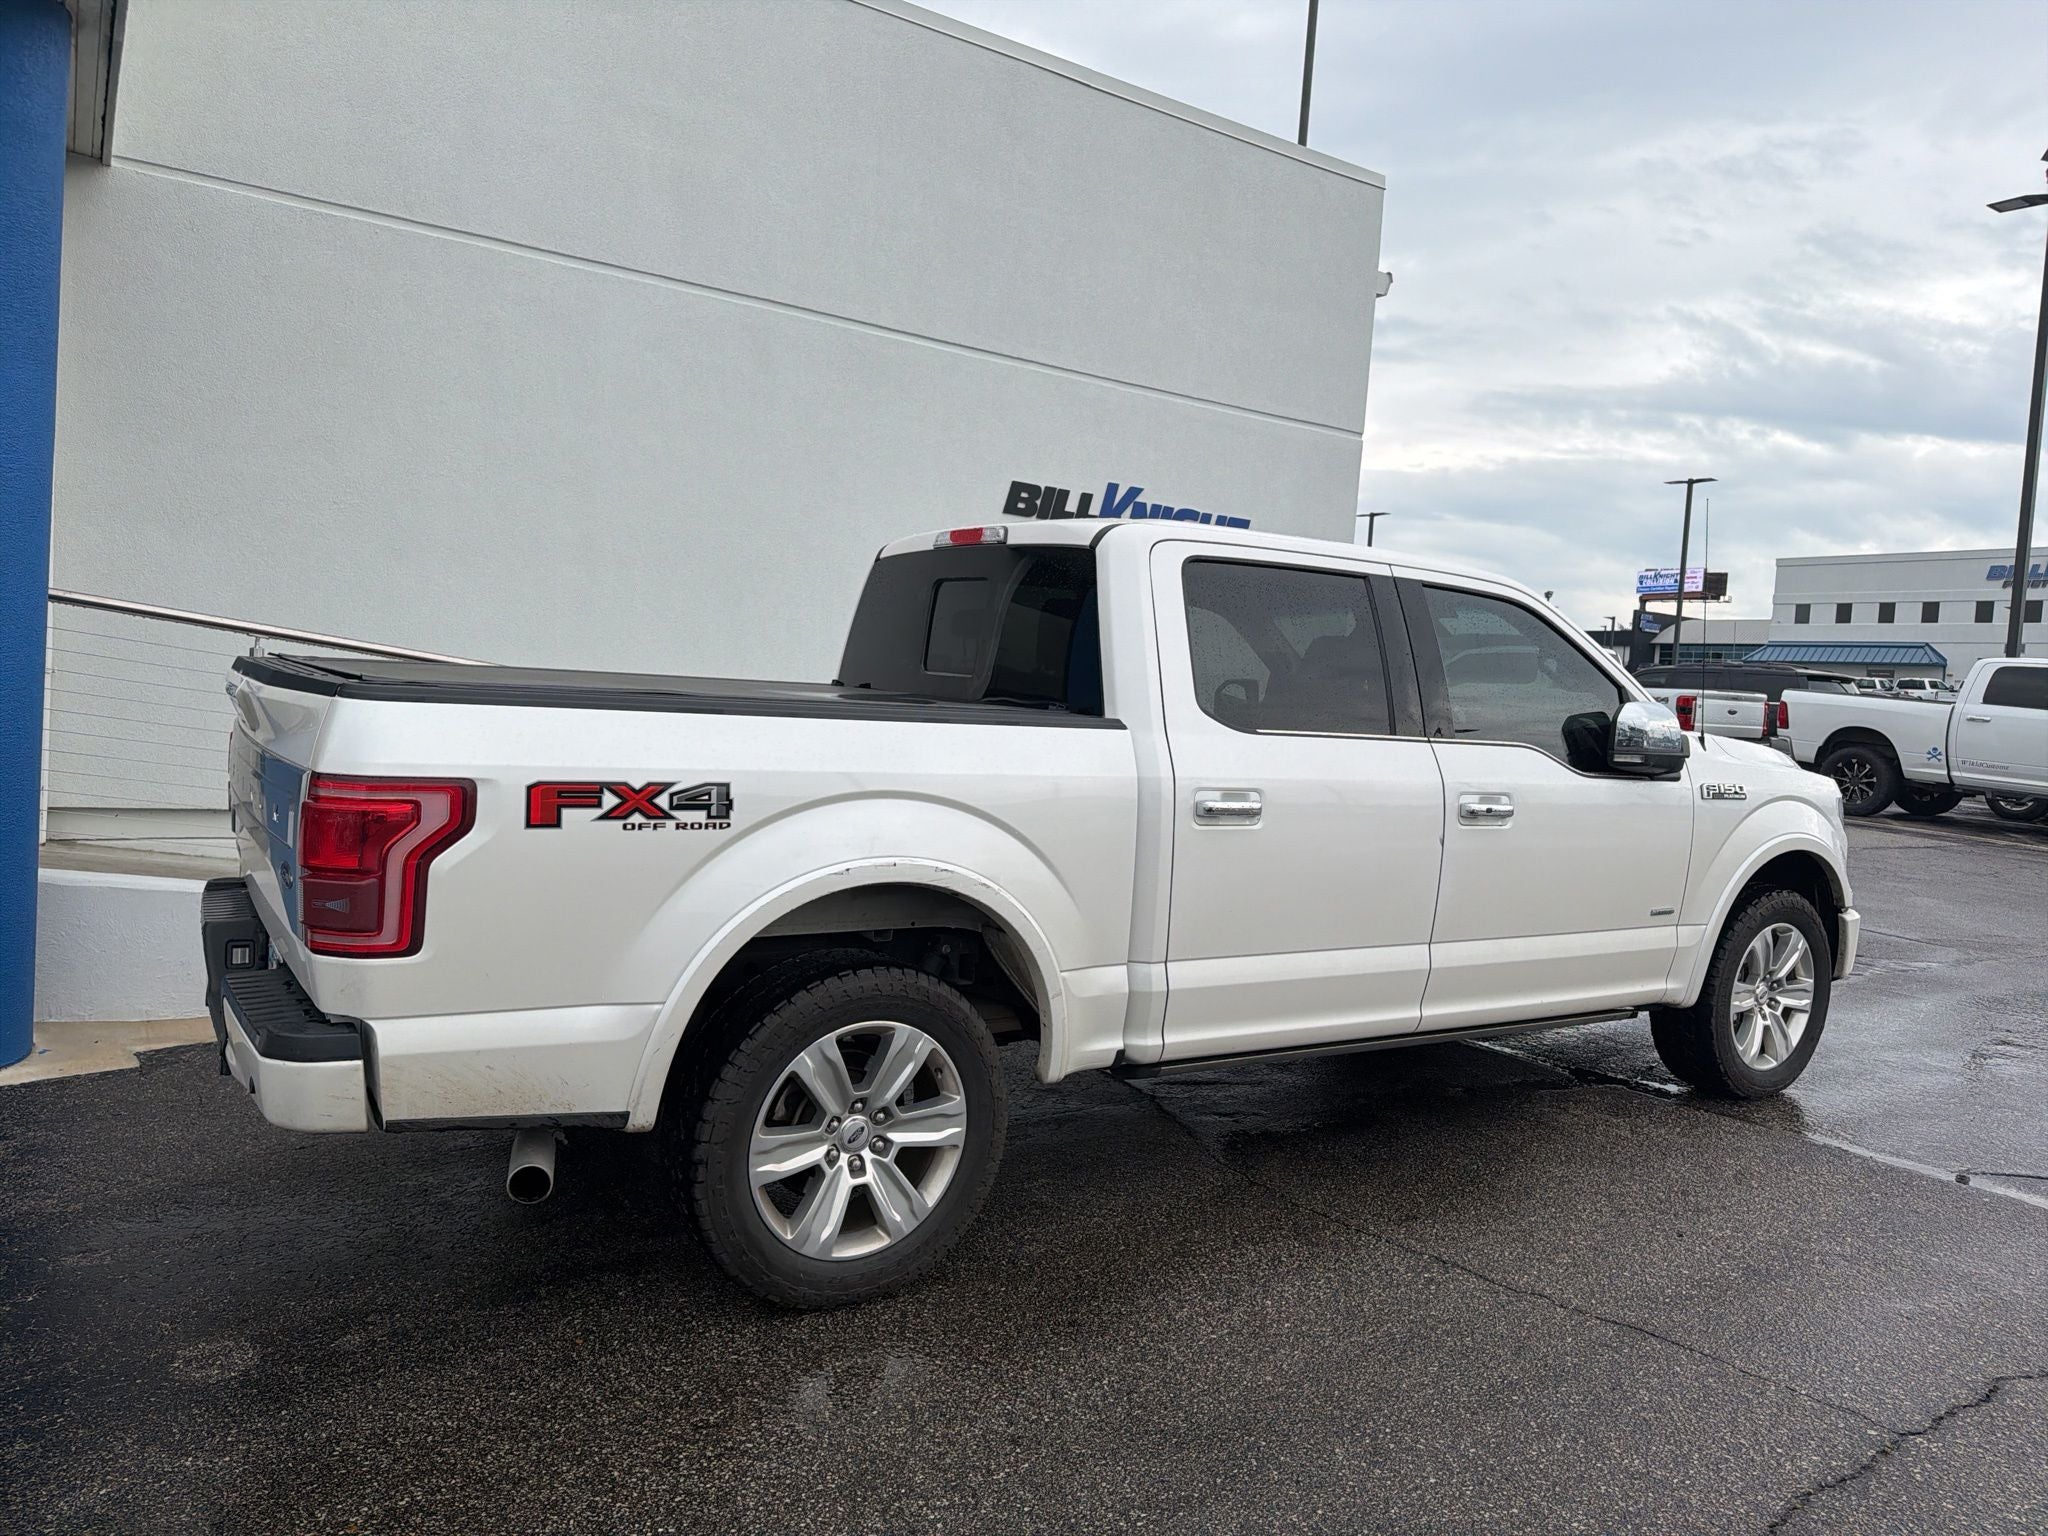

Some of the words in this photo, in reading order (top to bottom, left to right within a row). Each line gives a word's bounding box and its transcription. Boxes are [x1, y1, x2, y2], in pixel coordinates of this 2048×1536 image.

[1003, 480, 1099, 520] BILL
[524, 781, 734, 829] FX4
[622, 822, 667, 831] OFF
[675, 821, 731, 831] ROAD
